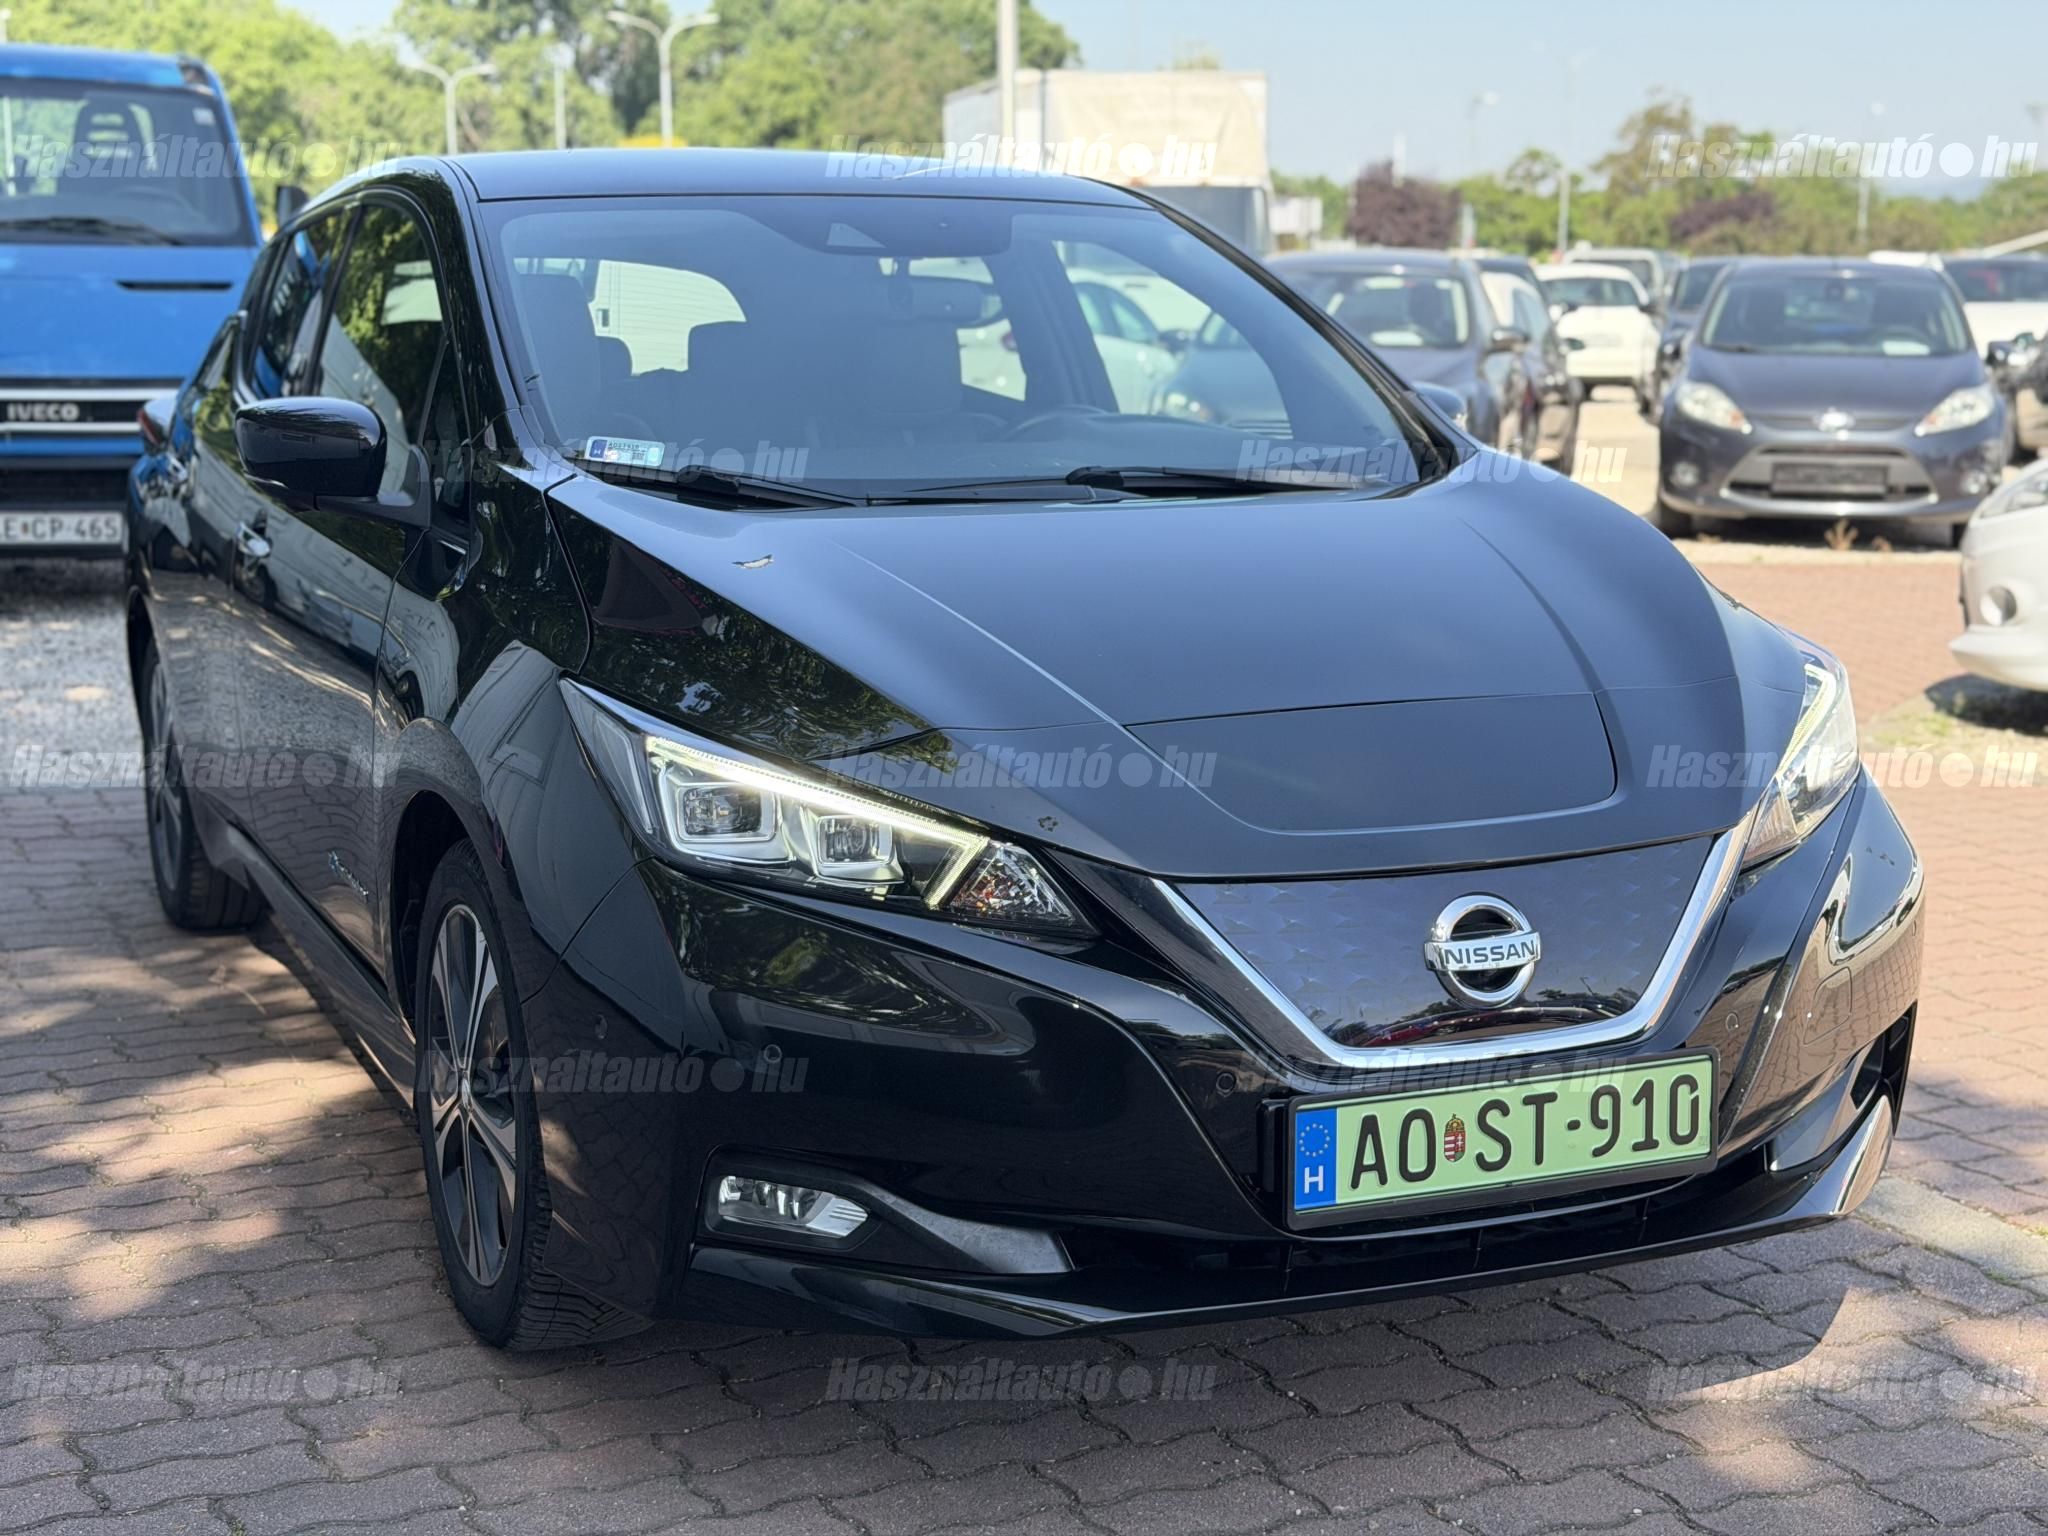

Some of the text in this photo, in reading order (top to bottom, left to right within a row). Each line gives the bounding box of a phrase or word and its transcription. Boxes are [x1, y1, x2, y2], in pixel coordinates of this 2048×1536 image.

[7, 402, 79, 421] IVECO
[1444, 940, 1536, 965] NISSAN
[1303, 1165, 1325, 1194] H
